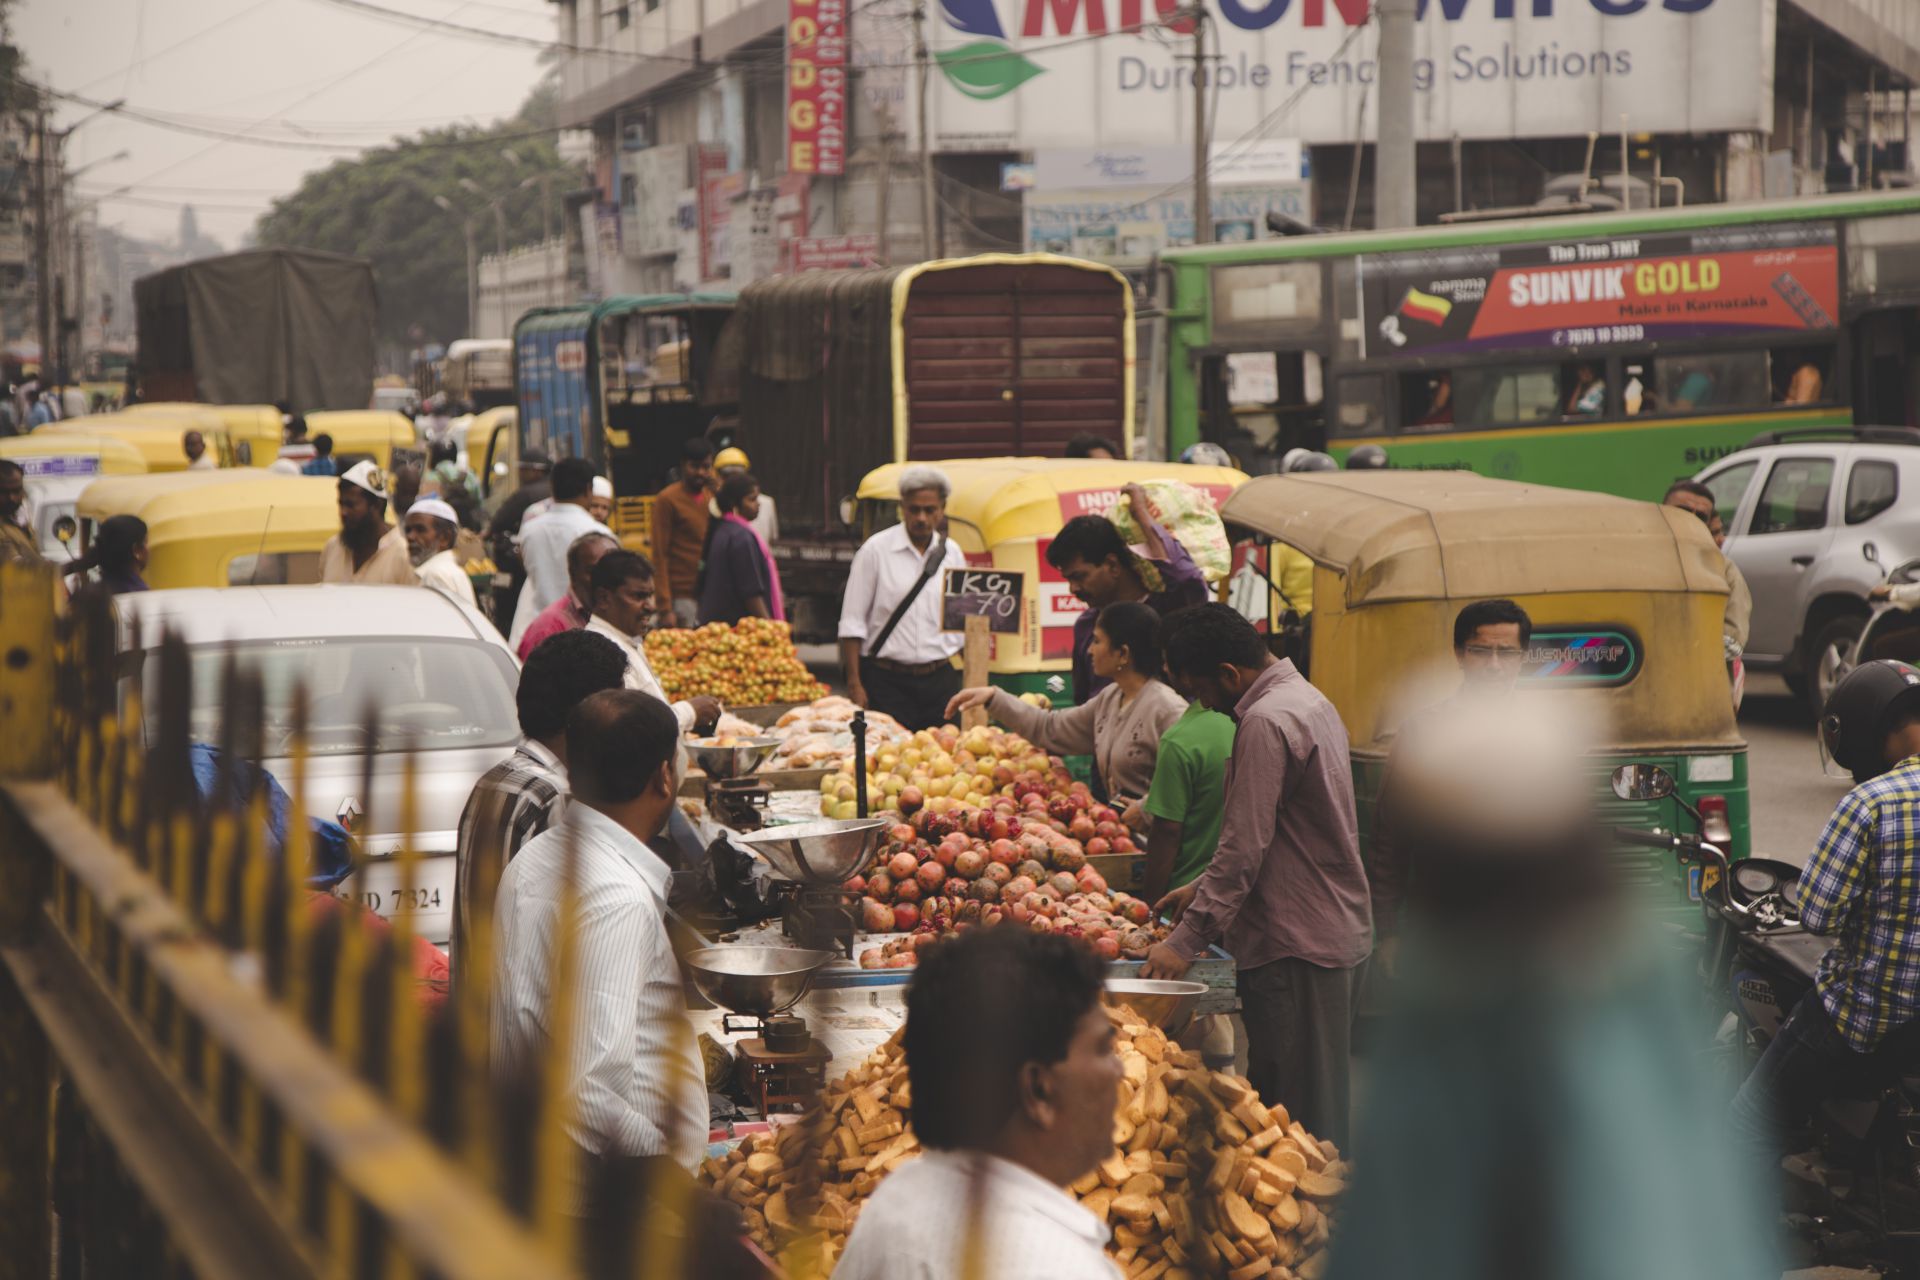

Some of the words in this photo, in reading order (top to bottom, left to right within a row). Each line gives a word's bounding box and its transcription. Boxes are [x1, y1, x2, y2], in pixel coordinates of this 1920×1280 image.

[1286, 51, 1435, 91] Fencg
[1453, 42, 1632, 83] Solutions
[790, 0, 816, 172] ODGE
[1549, 245, 1576, 262] The
[1577, 243, 1610, 260] True
[1611, 239, 1641, 257] TMT
[1509, 266, 1626, 308] SUNVIK
[1634, 257, 1721, 297] GOLD
[1619, 303, 1661, 318] Make
[1667, 302, 1681, 314] in
[1685, 295, 1768, 313] Karnataka
[976, 592, 1016, 617] 70
